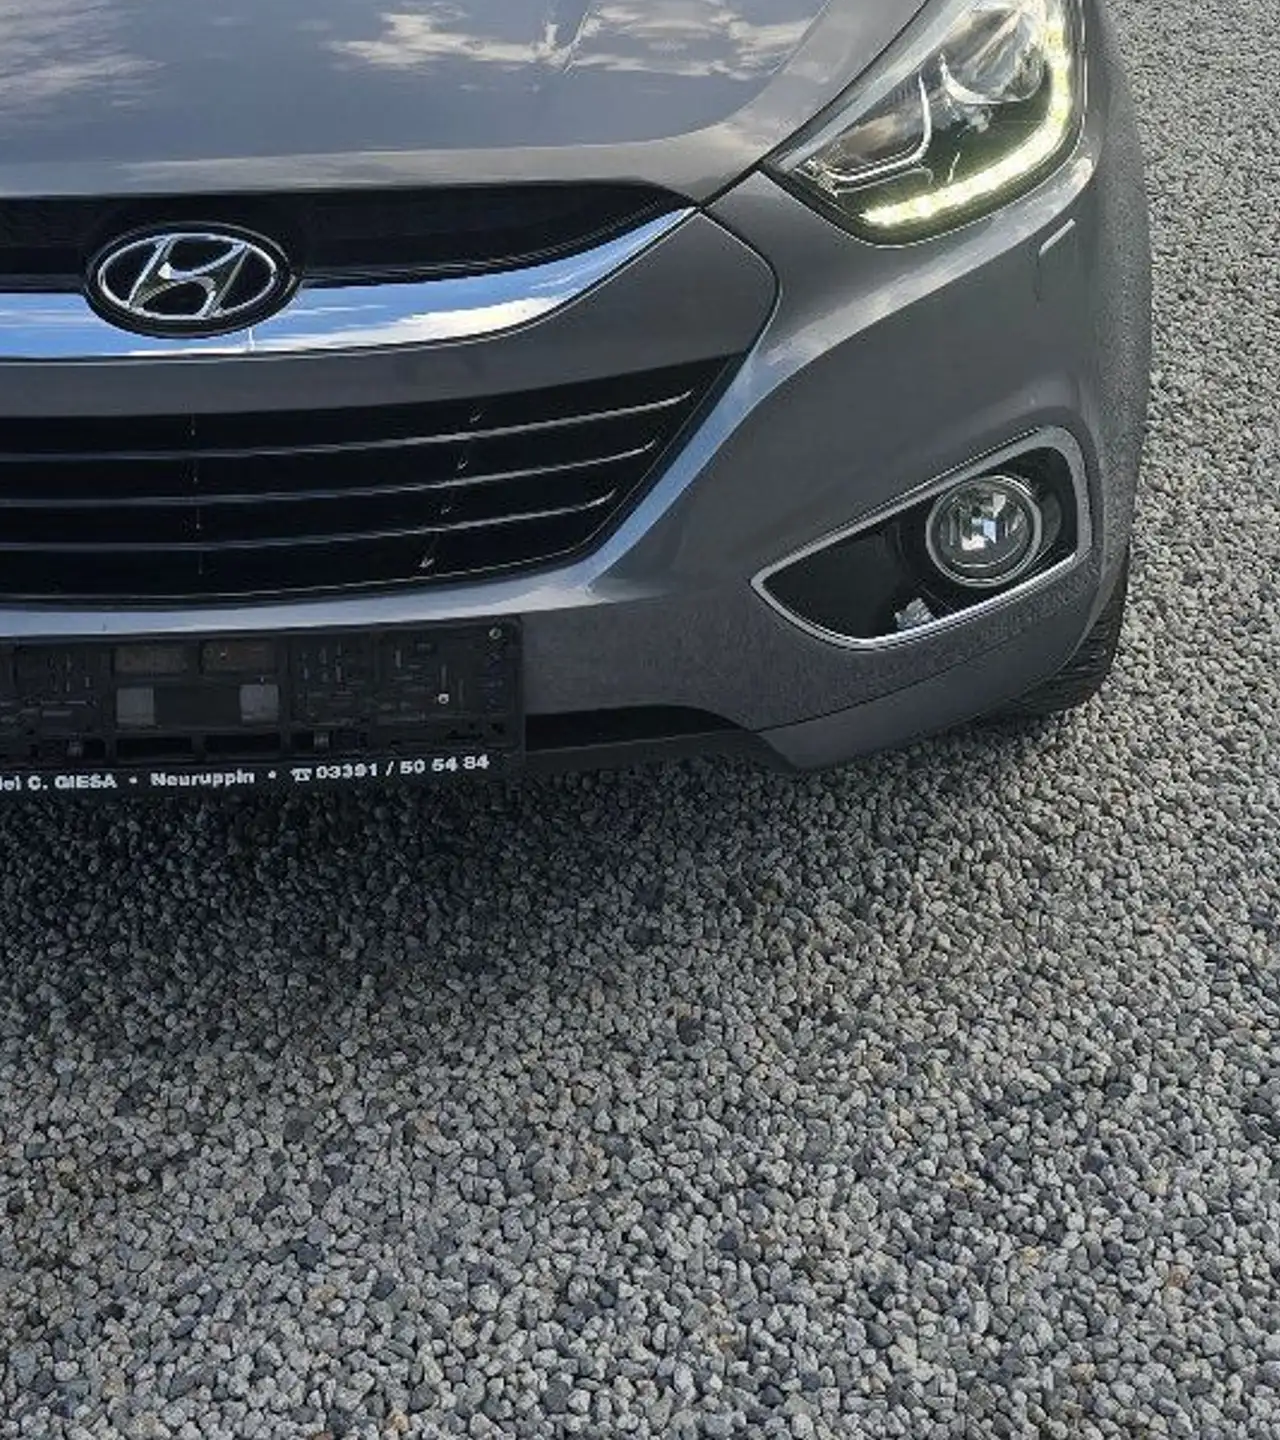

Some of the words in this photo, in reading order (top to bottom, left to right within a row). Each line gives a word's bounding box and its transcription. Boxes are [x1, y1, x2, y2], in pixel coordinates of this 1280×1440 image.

[27, 774, 48, 791] C.
[54, 772, 118, 790] GIESA
[150, 768, 255, 788] Neuruppin
[400, 758, 426, 775] 50
[431, 756, 458, 773] 54
[462, 754, 490, 771] 84
